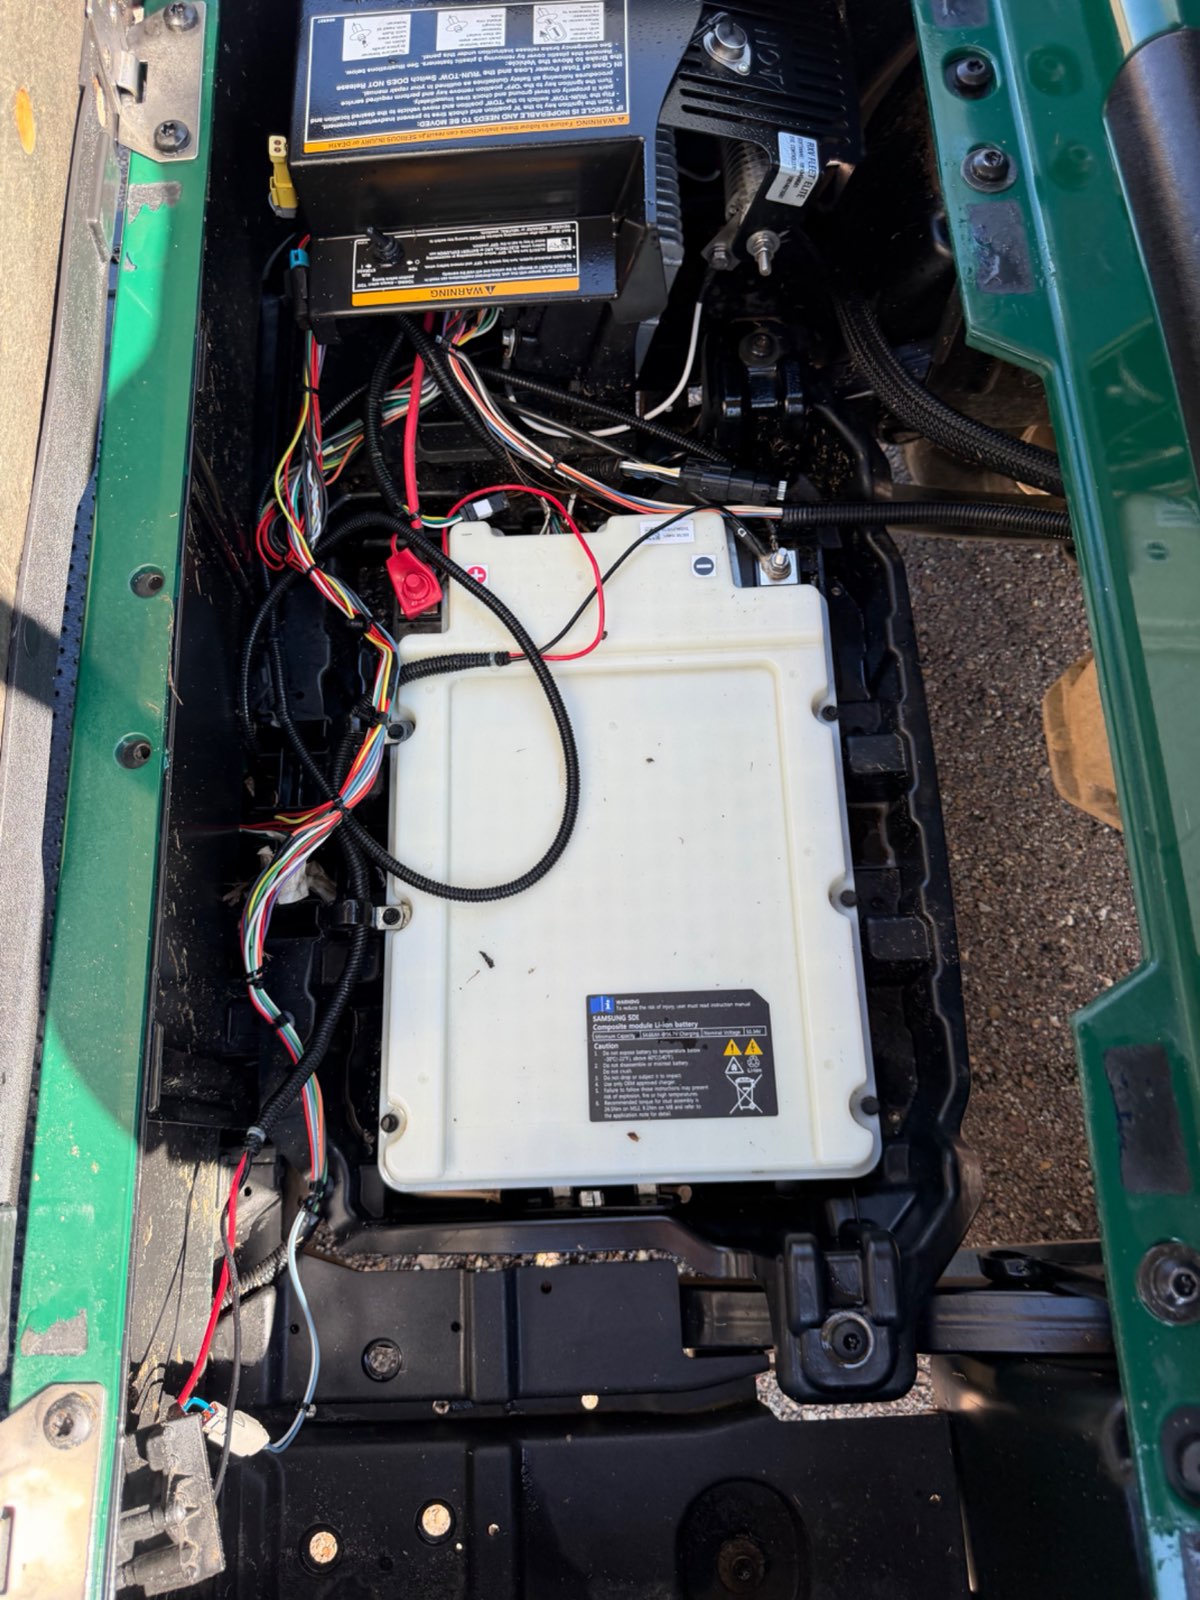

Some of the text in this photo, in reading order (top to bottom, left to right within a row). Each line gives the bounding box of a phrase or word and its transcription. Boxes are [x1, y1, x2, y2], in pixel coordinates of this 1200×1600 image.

[386, 77, 408, 86] DOES
[410, 74, 436, 83] Switch
[335, 82, 366, 91] Release
[519, 109, 569, 118] INOPERABLE
[581, 105, 614, 113] VEHICLE
[416, 118, 446, 127] MOVED:
[576, 117, 614, 126] WARNING
[458, 126, 501, 135] instructions
[386, 134, 416, 142] SERIOUS
[430, 286, 482, 297] WARNING
[592, 1023, 626, 1031] Composite
[674, 1020, 698, 1028] battery
